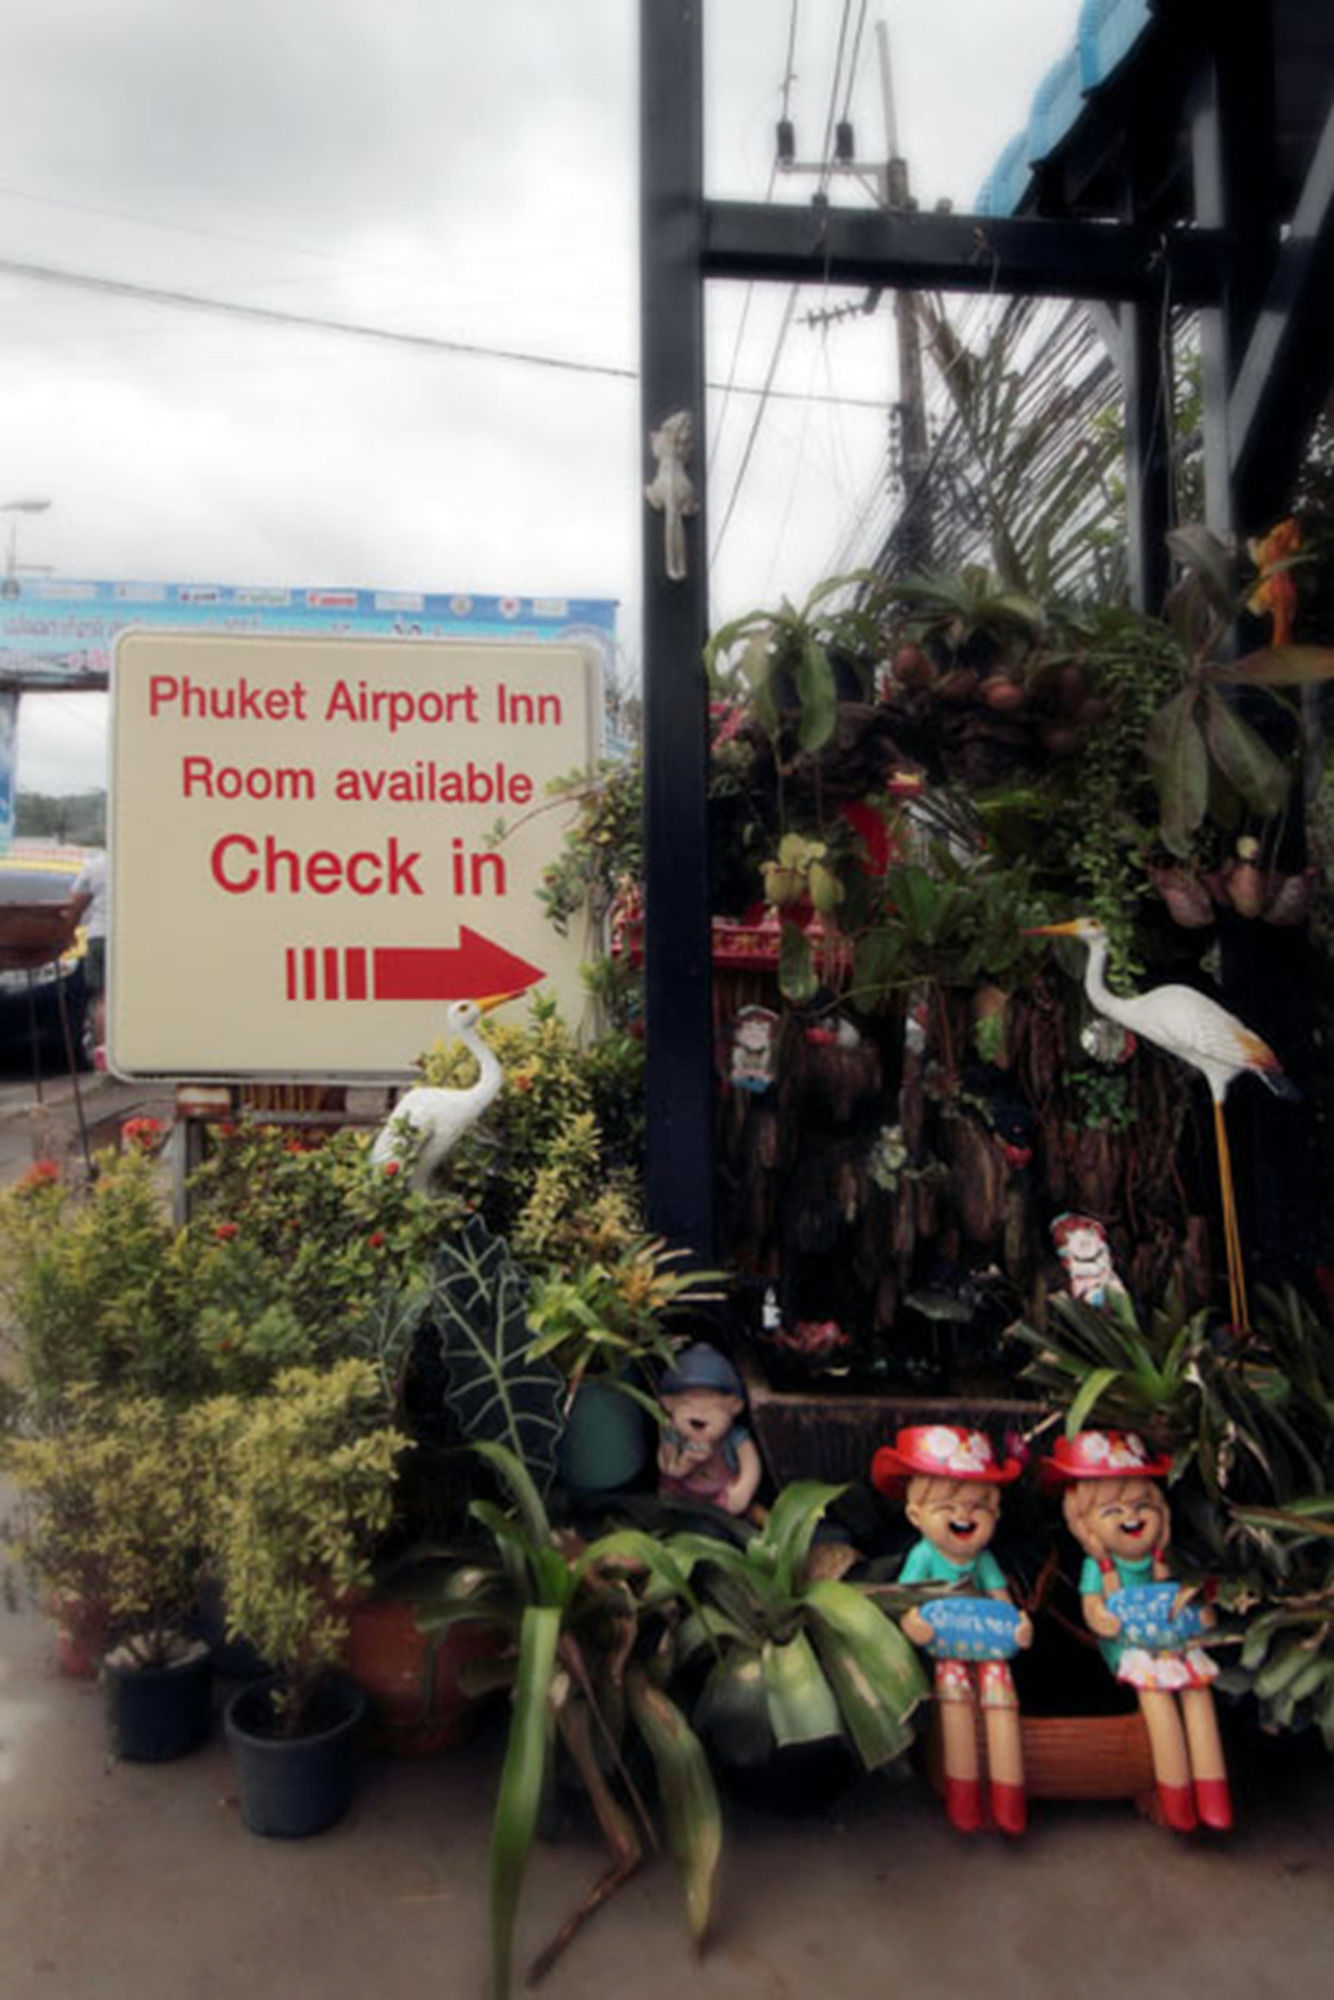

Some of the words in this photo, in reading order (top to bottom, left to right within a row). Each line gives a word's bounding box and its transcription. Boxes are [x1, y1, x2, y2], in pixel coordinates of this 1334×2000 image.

[149, 675, 307, 721] Phuket
[325, 680, 476, 733] Airport
[498, 684, 562, 726] Inn
[182, 756, 316, 800] Room
[335, 762, 534, 805] available
[210, 833, 423, 896] Check
[453, 838, 507, 896] in
